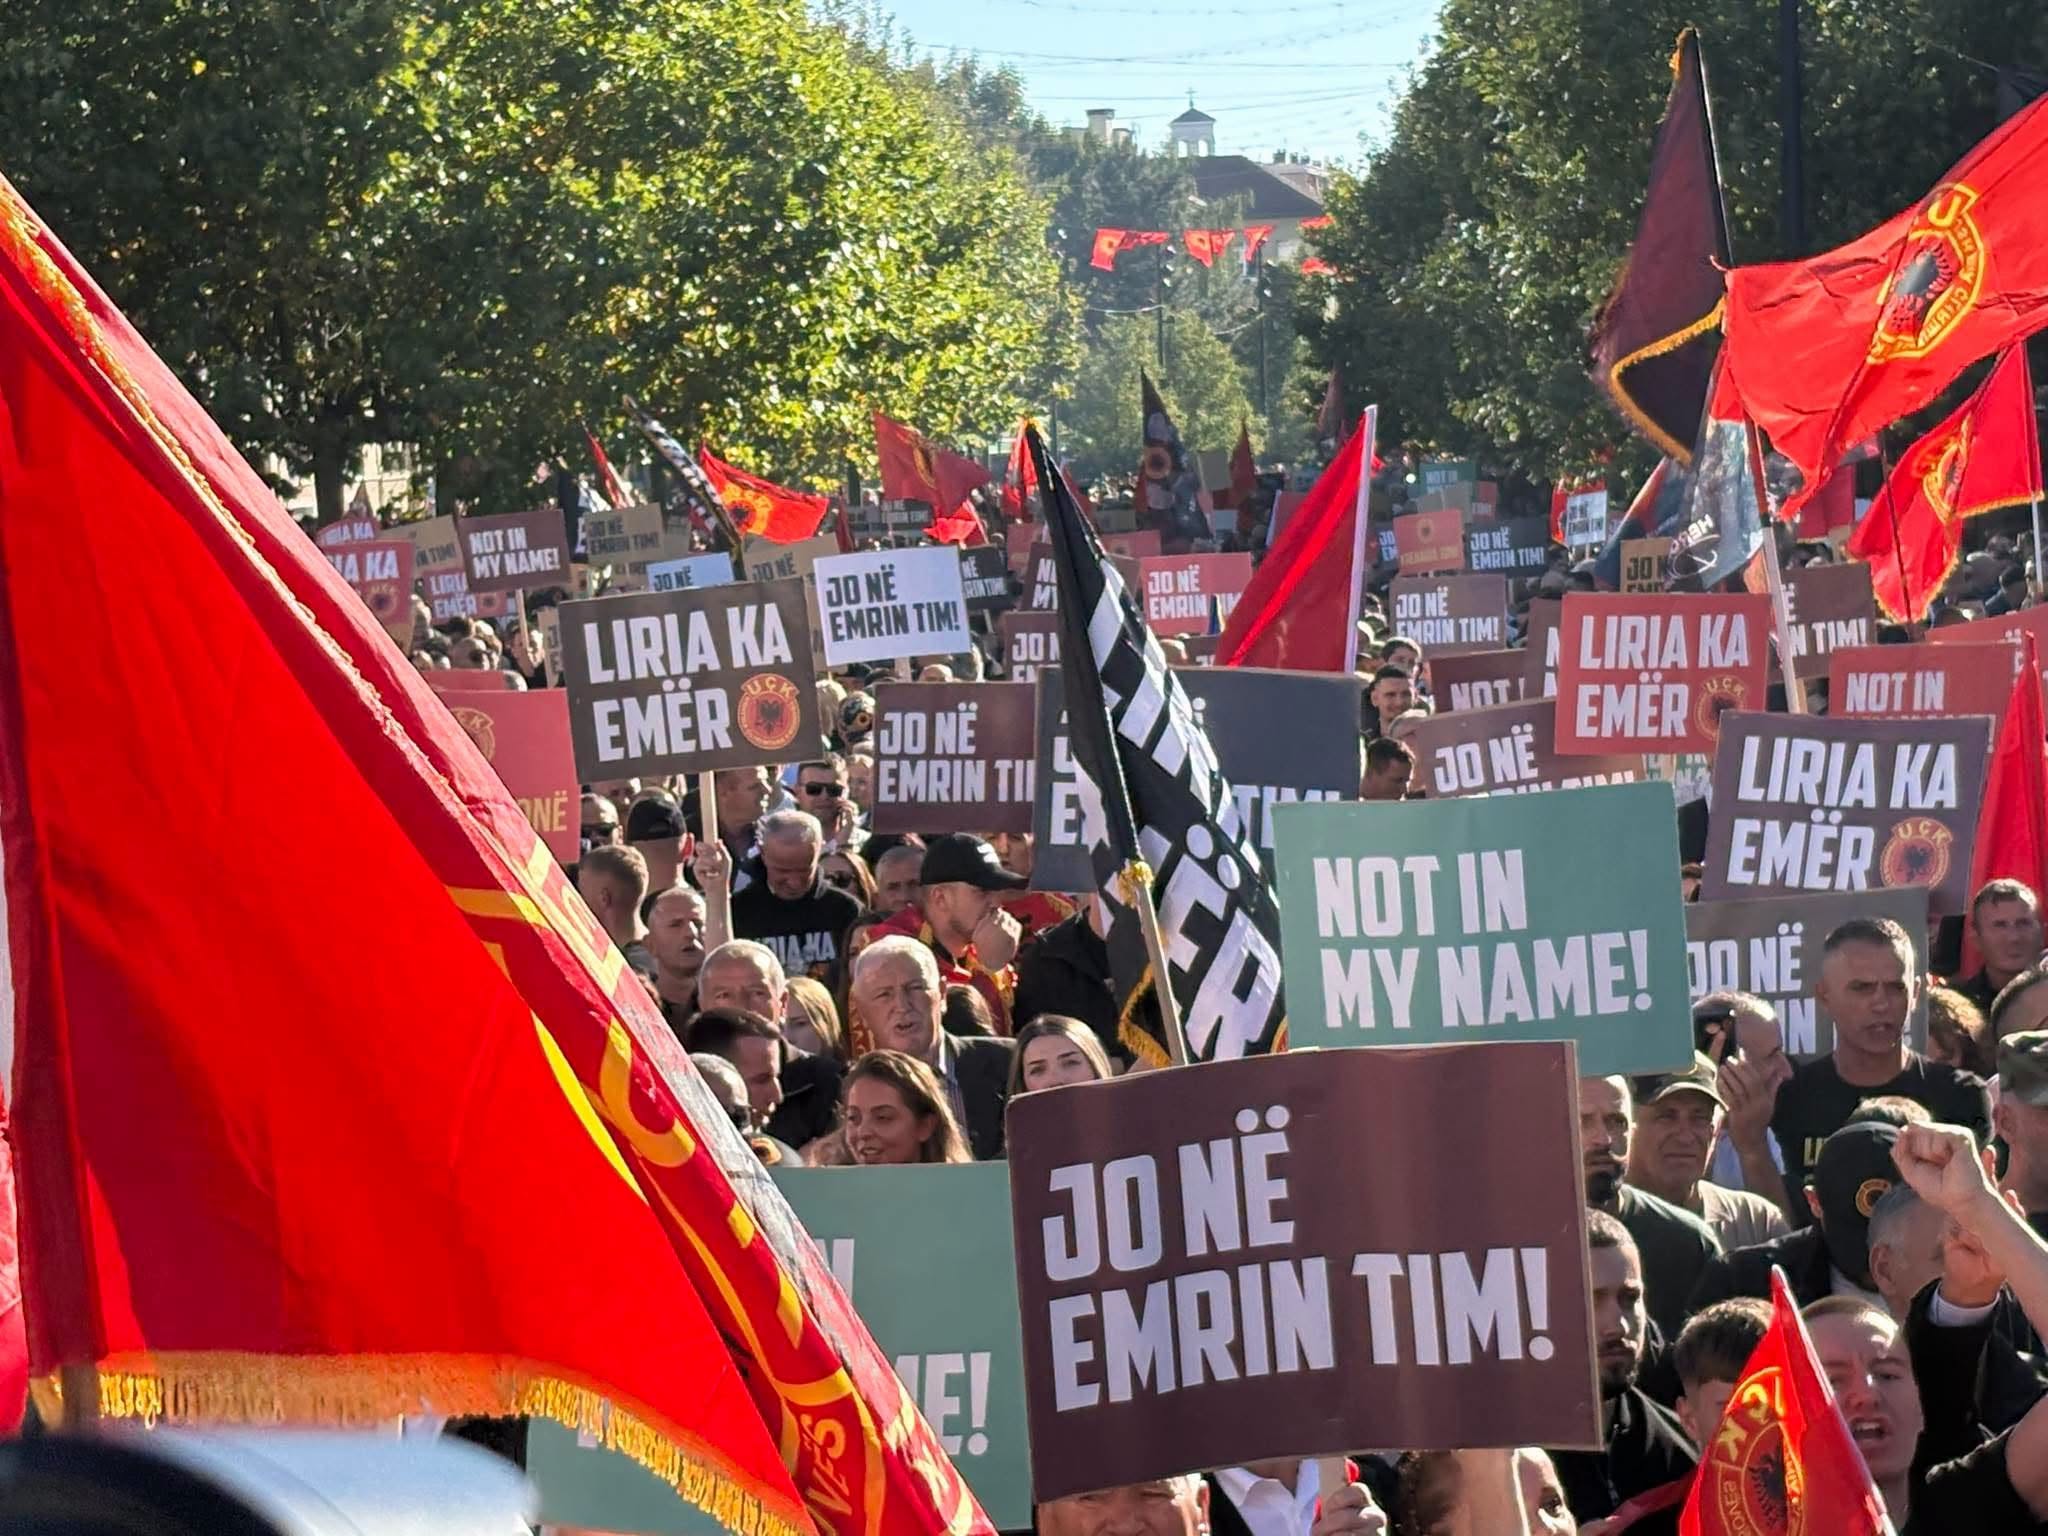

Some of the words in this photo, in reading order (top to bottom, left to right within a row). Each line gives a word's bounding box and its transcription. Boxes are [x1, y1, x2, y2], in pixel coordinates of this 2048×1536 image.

[469, 529, 504, 554] NOT
[507, 527, 528, 550] IN
[1471, 533, 1488, 551] JO
[1491, 526, 1511, 549] NË
[1472, 549, 1516, 569] EMRIN
[1518, 547, 1544, 566] TIM!
[365, 549, 400, 580] KA
[473, 554, 501, 579] MY
[504, 546, 560, 575] NAME!
[654, 573, 672, 591] JO
[674, 565, 693, 588] NË
[1148, 571, 1173, 594] JO
[1177, 564, 1200, 592] NË
[1627, 557, 1653, 581] JO
[826, 575, 861, 608] JO
[865, 563, 897, 603] NË
[1149, 594, 1208, 620] EMRIN
[1396, 592, 1420, 618] JO
[1425, 586, 1449, 616] NË
[1780, 583, 1796, 622] Ë
[584, 610, 721, 684] LIRIA
[727, 602, 793, 669] KA
[829, 603, 909, 643] EMRIN
[912, 601, 961, 635] TIM!
[1396, 618, 1455, 646] EMRIN
[1457, 617, 1499, 642] TIM!
[1579, 615, 1688, 670] LIRIA
[1699, 614, 1749, 668] KA
[1012, 633, 1044, 662] JO
[1576, 672, 1690, 738] EMËR
[1845, 671, 1908, 713] NOT
[1912, 671, 1945, 711] IN
[593, 677, 733, 762] EMËR
[880, 712, 927, 755] JO
[934, 702, 978, 755] NË
[1434, 743, 1485, 793] JO
[1488, 723, 1538, 783] NË
[1737, 736, 1876, 809] LIRIA
[1890, 743, 1957, 810] KA
[878, 759, 986, 803] EMRIN
[1727, 808, 1876, 891] EMËR
[1313, 855, 1440, 938] NOT
[1457, 849, 1527, 934] IN
[1320, 948, 1420, 1029] MY
[1437, 929, 1652, 1028] NAME!
[1750, 922, 1804, 994] NË
[1042, 1155, 1163, 1282] JO
[1178, 1105, 1295, 1257] NË
[1049, 1256, 1334, 1413] EMRIN
[1352, 1247, 1554, 1366] TIM!
